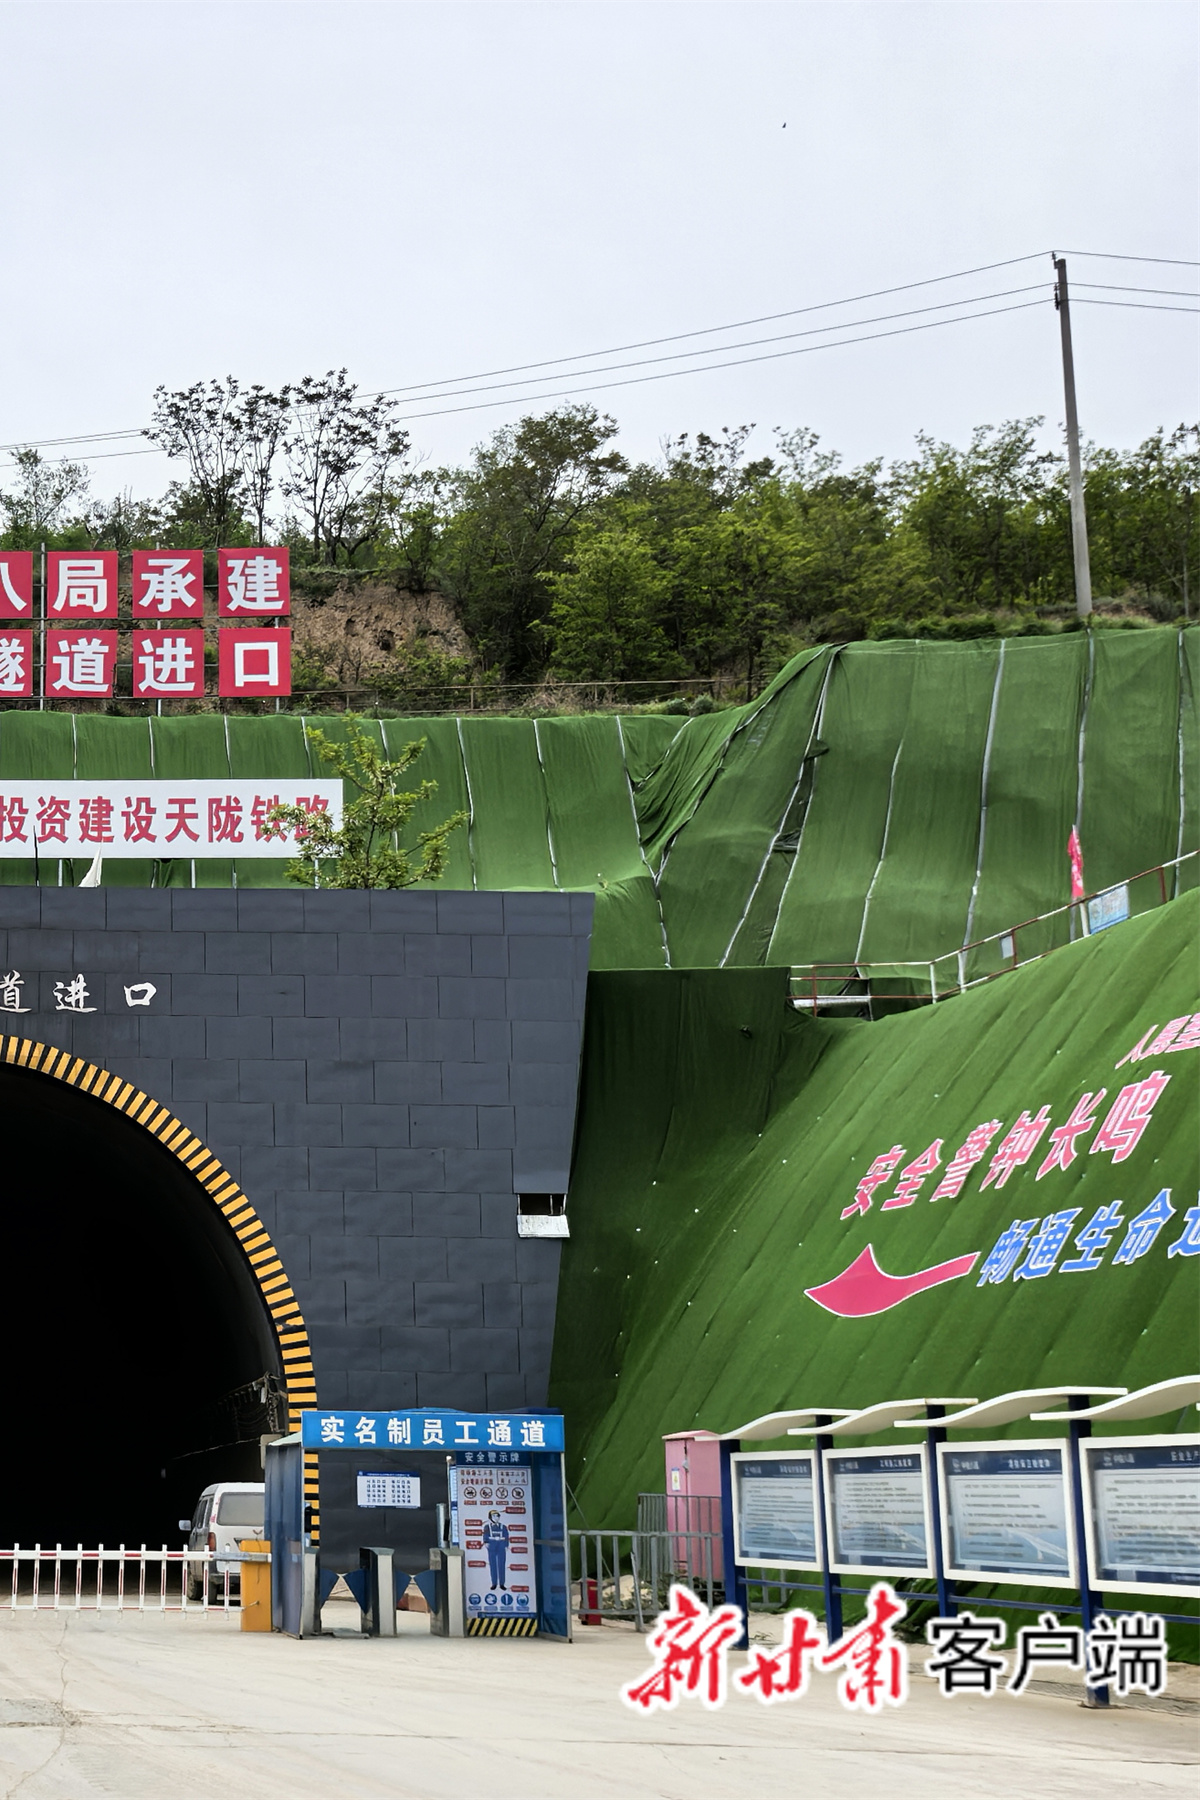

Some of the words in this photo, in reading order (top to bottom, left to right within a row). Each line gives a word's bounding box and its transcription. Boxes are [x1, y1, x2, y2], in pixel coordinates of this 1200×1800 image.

[840, 1069, 1172, 1221] 安全警钟长鸣
[320, 1415, 547, 1448] 实名制员工通道
[464, 1451, 520, 1463] 安全警示牌
